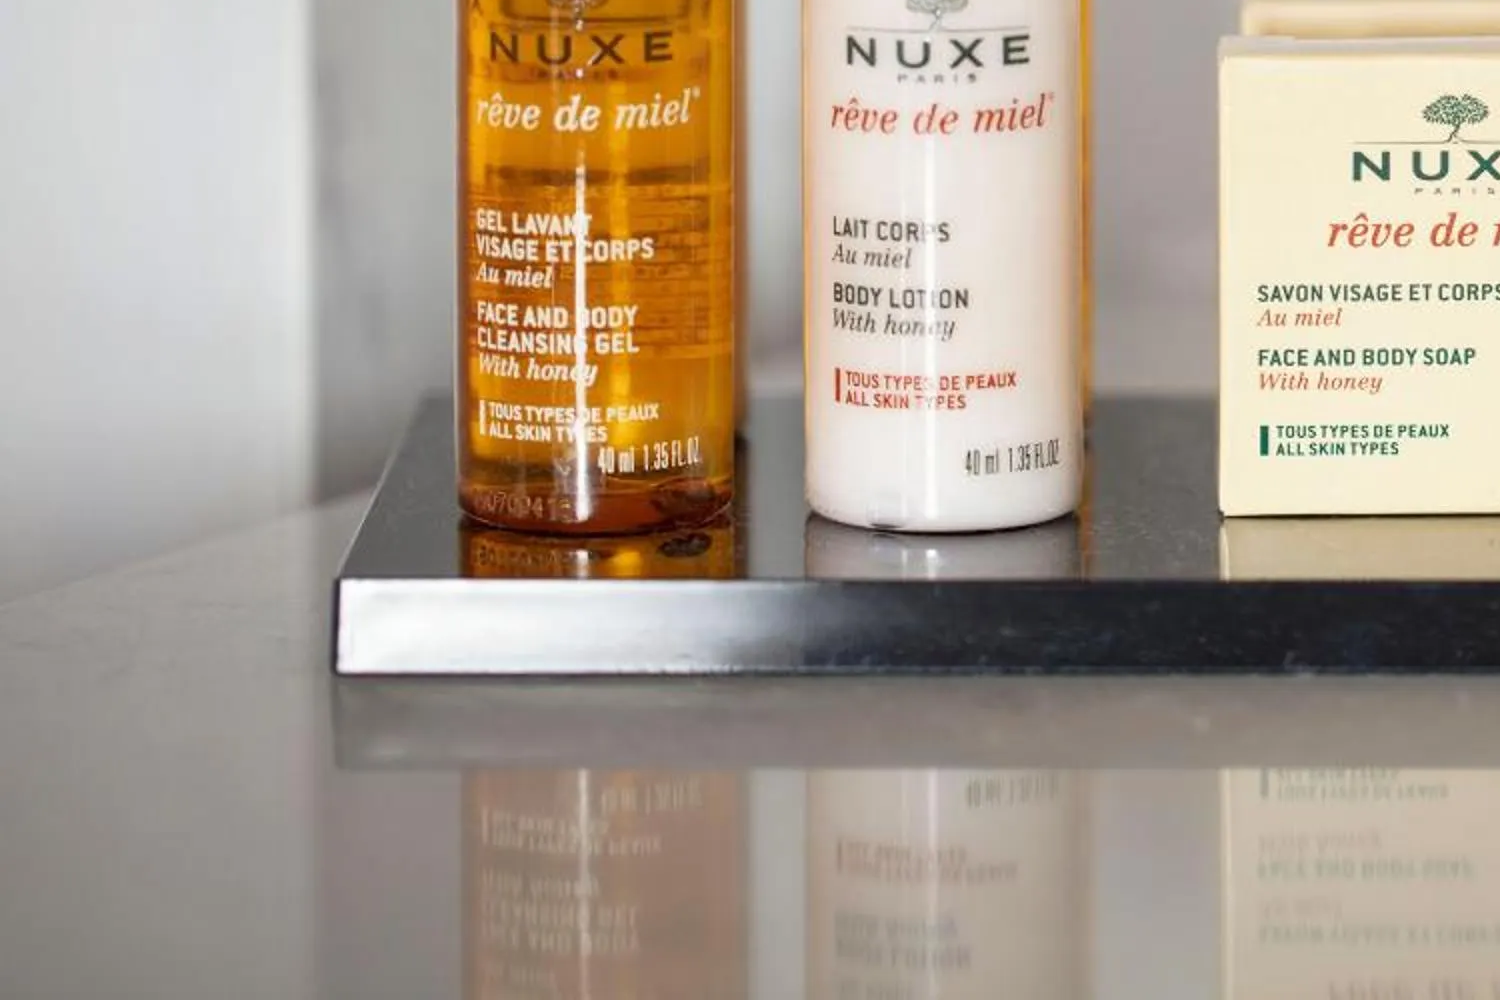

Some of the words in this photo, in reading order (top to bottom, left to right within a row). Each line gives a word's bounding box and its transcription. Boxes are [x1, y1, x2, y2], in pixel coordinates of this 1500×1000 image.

[490, 31, 673, 65] NUXE
[846, 35, 1030, 69] NUXE
[898, 73, 977, 84] PARIS
[476, 92, 541, 130] rêve
[554, 94, 601, 132] de
[831, 97, 898, 134] rêve
[913, 103, 959, 135] de
[1414, 187, 1496, 195] PARIS
[476, 207, 508, 233] GEL
[833, 216, 869, 239] LAIT
[1327, 212, 1415, 248] rêve
[1429, 211, 1479, 248] de
[476, 234, 538, 261] VISAGE
[545, 240, 572, 262] ET
[578, 238, 655, 262] CORPS
[832, 242, 857, 265] Au
[863, 248, 912, 269] miel
[476, 262, 500, 284] Au
[504, 263, 554, 289] miel
[833, 282, 882, 306] BODY
[1257, 284, 1324, 303] SAVON
[1329, 283, 1402, 302] VISAGE
[1409, 283, 1432, 301] ET
[477, 300, 518, 326] FACE
[523, 306, 568, 329] AND
[832, 308, 876, 334] With
[1256, 308, 1287, 327] Au
[1294, 307, 1343, 327] miel
[477, 326, 588, 355] CLEANSING
[595, 332, 640, 355] GEL
[479, 352, 520, 379] With
[1257, 349, 1309, 366] FACE
[1313, 349, 1355, 366] AND
[1361, 348, 1417, 366] BODY
[1422, 347, 1475, 366] SOAP
[845, 371, 880, 389] TOUS
[939, 375, 961, 391] DE
[965, 371, 1017, 390] PEAUX
[1258, 372, 1309, 391] With
[1316, 372, 1383, 395] honey
[845, 390, 869, 407] ALL
[873, 393, 910, 409] SKIN
[489, 402, 522, 422] TOUS
[525, 405, 576, 424] TYPES
[606, 403, 659, 423] PEAUX
[489, 424, 512, 440] ALL
[515, 424, 551, 441] SKIN
[556, 426, 608, 443] TYES
[1276, 425, 1317, 439] TOUS
[1320, 425, 1369, 439] TYPES
[1373, 425, 1393, 438] DE
[1397, 424, 1450, 438] PEAUX
[597, 446, 615, 474] 40
[643, 441, 669, 472] 1.35
[965, 449, 981, 476] 40
[1008, 444, 1031, 473] 1.35
[1276, 443, 1305, 456] ALL
[1308, 442, 1346, 456] SKIN
[1350, 441, 1400, 456] TYPES
